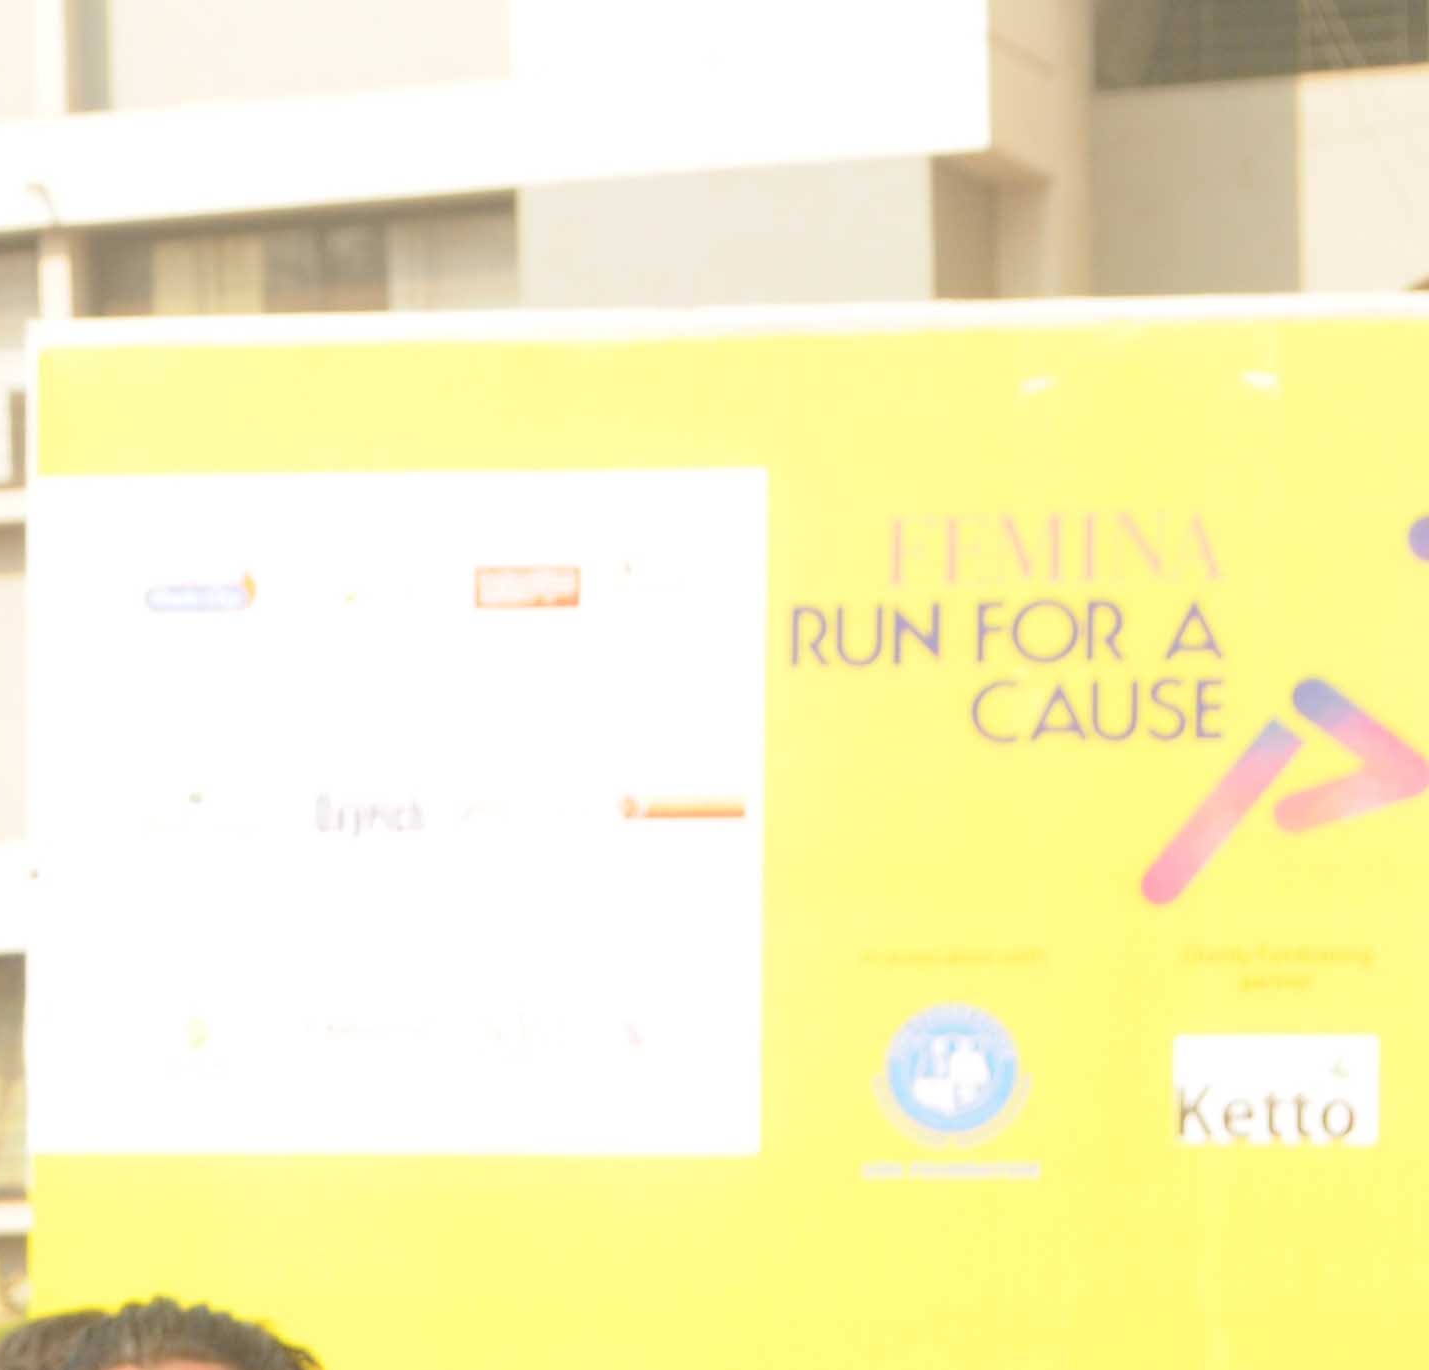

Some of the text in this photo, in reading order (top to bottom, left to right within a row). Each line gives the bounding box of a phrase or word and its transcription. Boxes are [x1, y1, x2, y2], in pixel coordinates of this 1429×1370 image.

[891, 512, 1222, 584] FEMINA
[790, 598, 1225, 667] RUN FOR A
[971, 677, 1225, 745] CAUSE
[1176, 1083, 1357, 1138] Ketto
